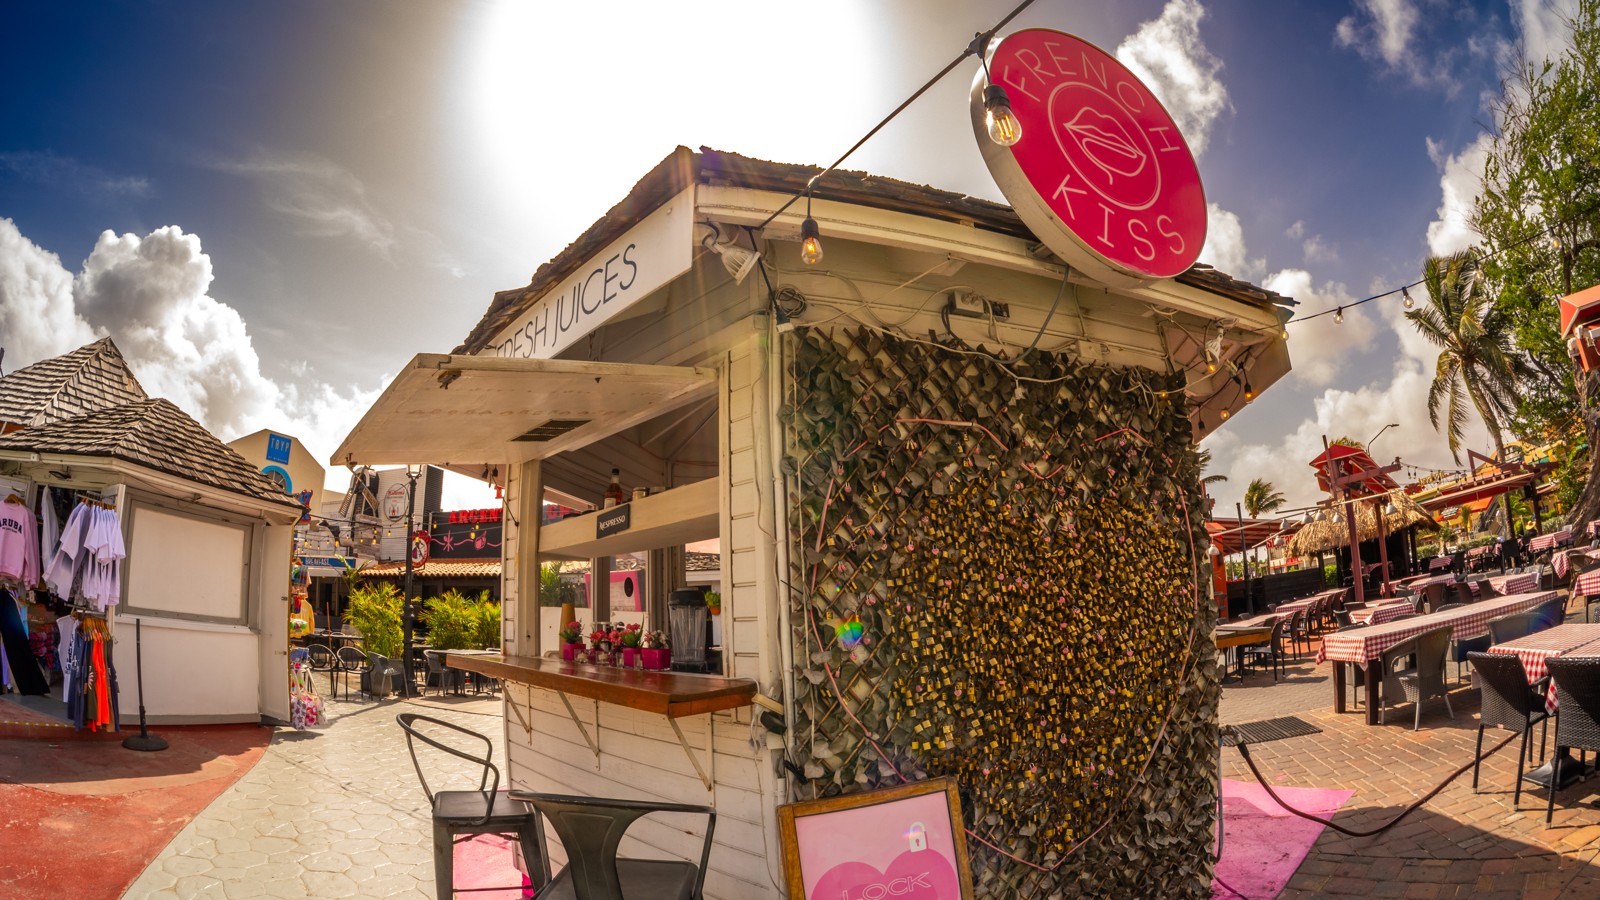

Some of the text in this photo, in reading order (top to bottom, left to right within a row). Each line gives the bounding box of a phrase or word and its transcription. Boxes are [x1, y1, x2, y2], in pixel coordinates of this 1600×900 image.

[1003, 41, 1180, 152] FRENCH
[1051, 174, 1185, 261] KISS
[552, 243, 638, 347] JUICES
[599, 515, 626, 530] NESPRESSO
